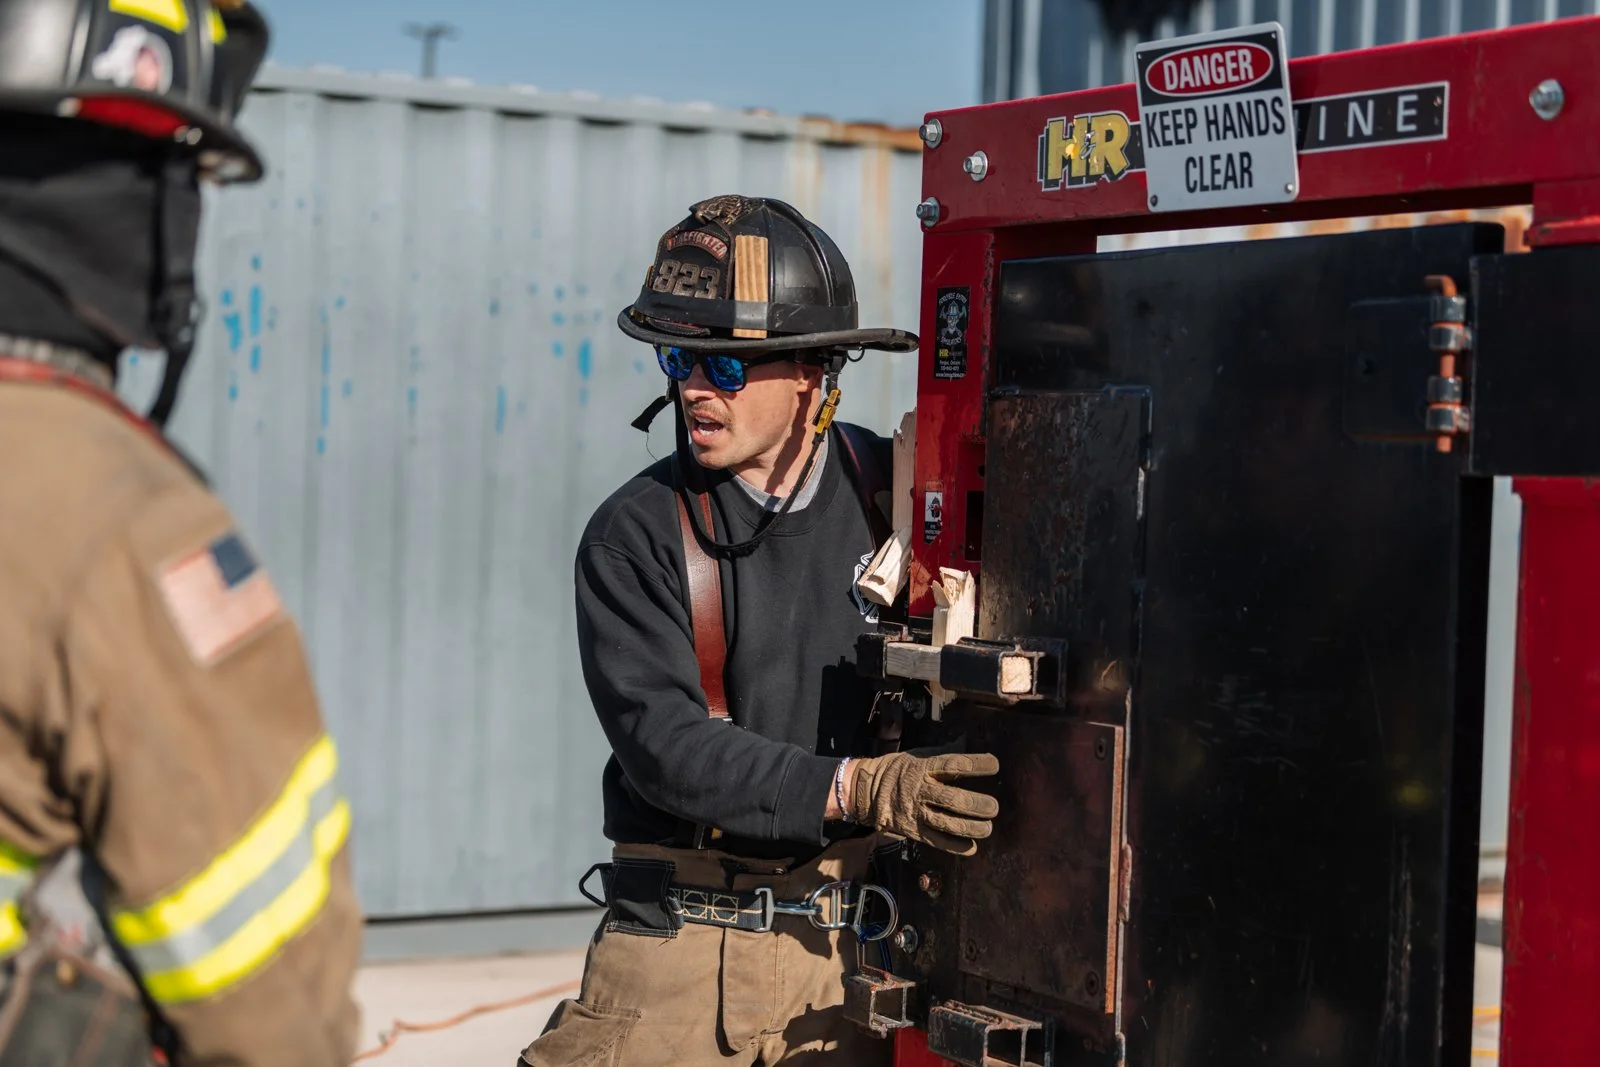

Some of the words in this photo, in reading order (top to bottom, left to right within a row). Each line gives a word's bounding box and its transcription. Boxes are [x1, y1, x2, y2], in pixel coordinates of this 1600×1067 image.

[1163, 49, 1253, 91] DANGER
[1145, 107, 1198, 148] KEEP
[1204, 96, 1285, 142] HANDS
[1185, 151, 1253, 193] CLEAR
[652, 259, 720, 299] 823
